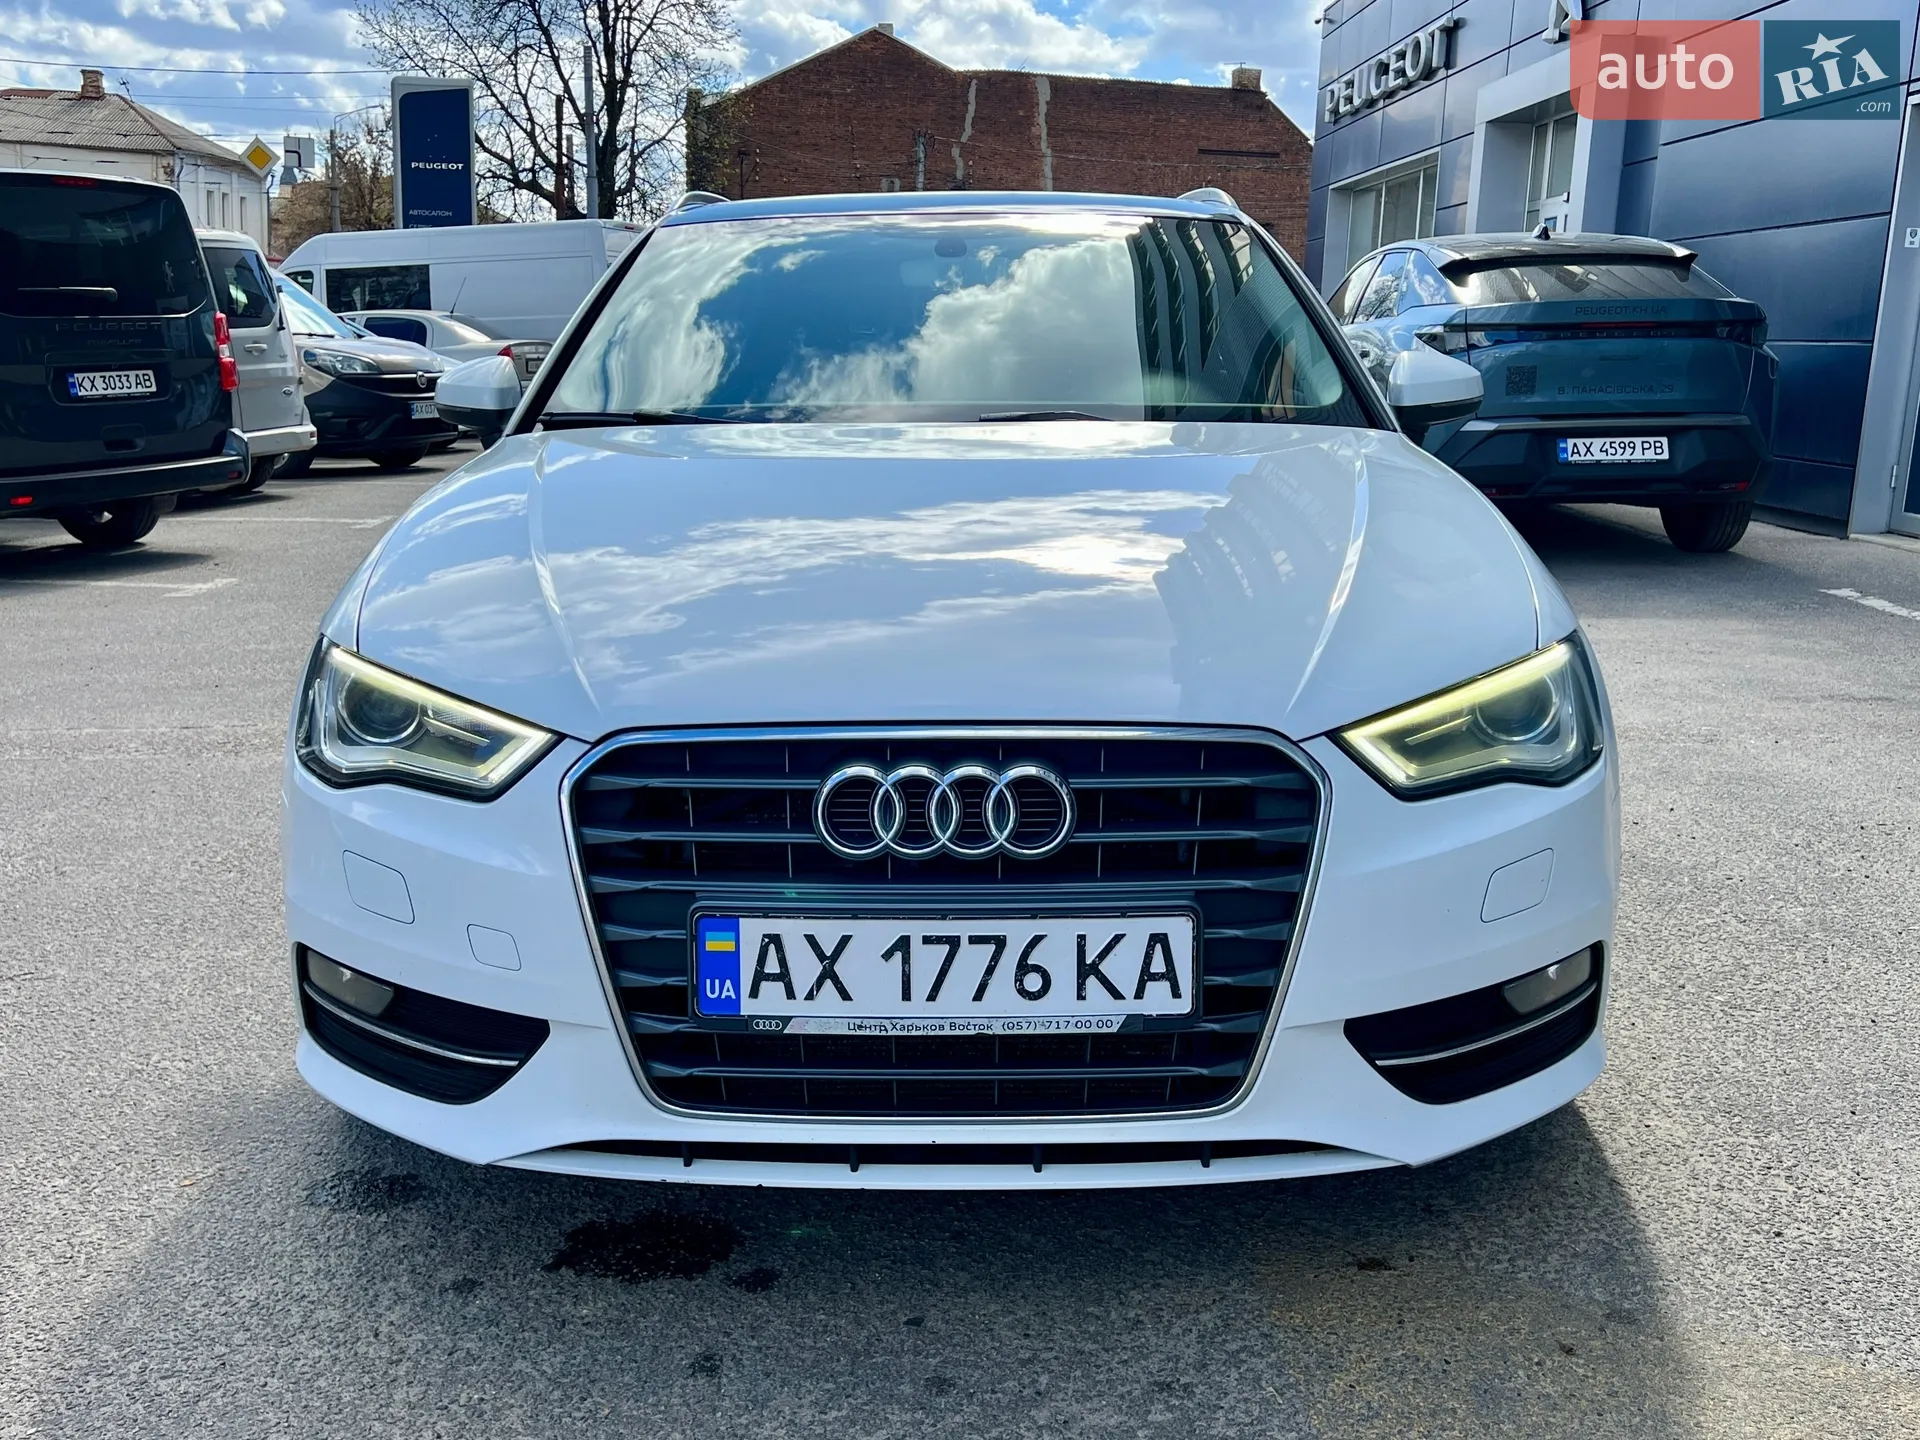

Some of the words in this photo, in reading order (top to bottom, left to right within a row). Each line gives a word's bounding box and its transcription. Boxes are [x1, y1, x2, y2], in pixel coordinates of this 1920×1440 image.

[1325, 17, 1454, 123] PEUGEOT
[411, 162, 464, 170] PEUGEOT
[408, 209, 453, 217] АВТОСАЛОН
[56, 322, 162, 332] PEUGEOT
[76, 375, 99, 392] KX
[101, 374, 132, 391] 3033
[135, 373, 153, 389] AB
[1661, 384, 1675, 394] 29
[1570, 441, 1595, 457] AX
[1600, 441, 1636, 456] 4599
[1641, 440, 1665, 456] PB
[748, 933, 854, 1002] AX
[880, 934, 1052, 1002] 1776
[1076, 932, 1183, 1001] KA
[705, 978, 736, 999] UA
[890, 1021, 945, 1033] Харьков
[949, 1021, 994, 1031] Восток
[1001, 1020, 1038, 1031] (057)
[1046, 1020, 1070, 1030] 717
[1074, 1019, 1092, 1029] 00
[1096, 1019, 1113, 1029] 00
